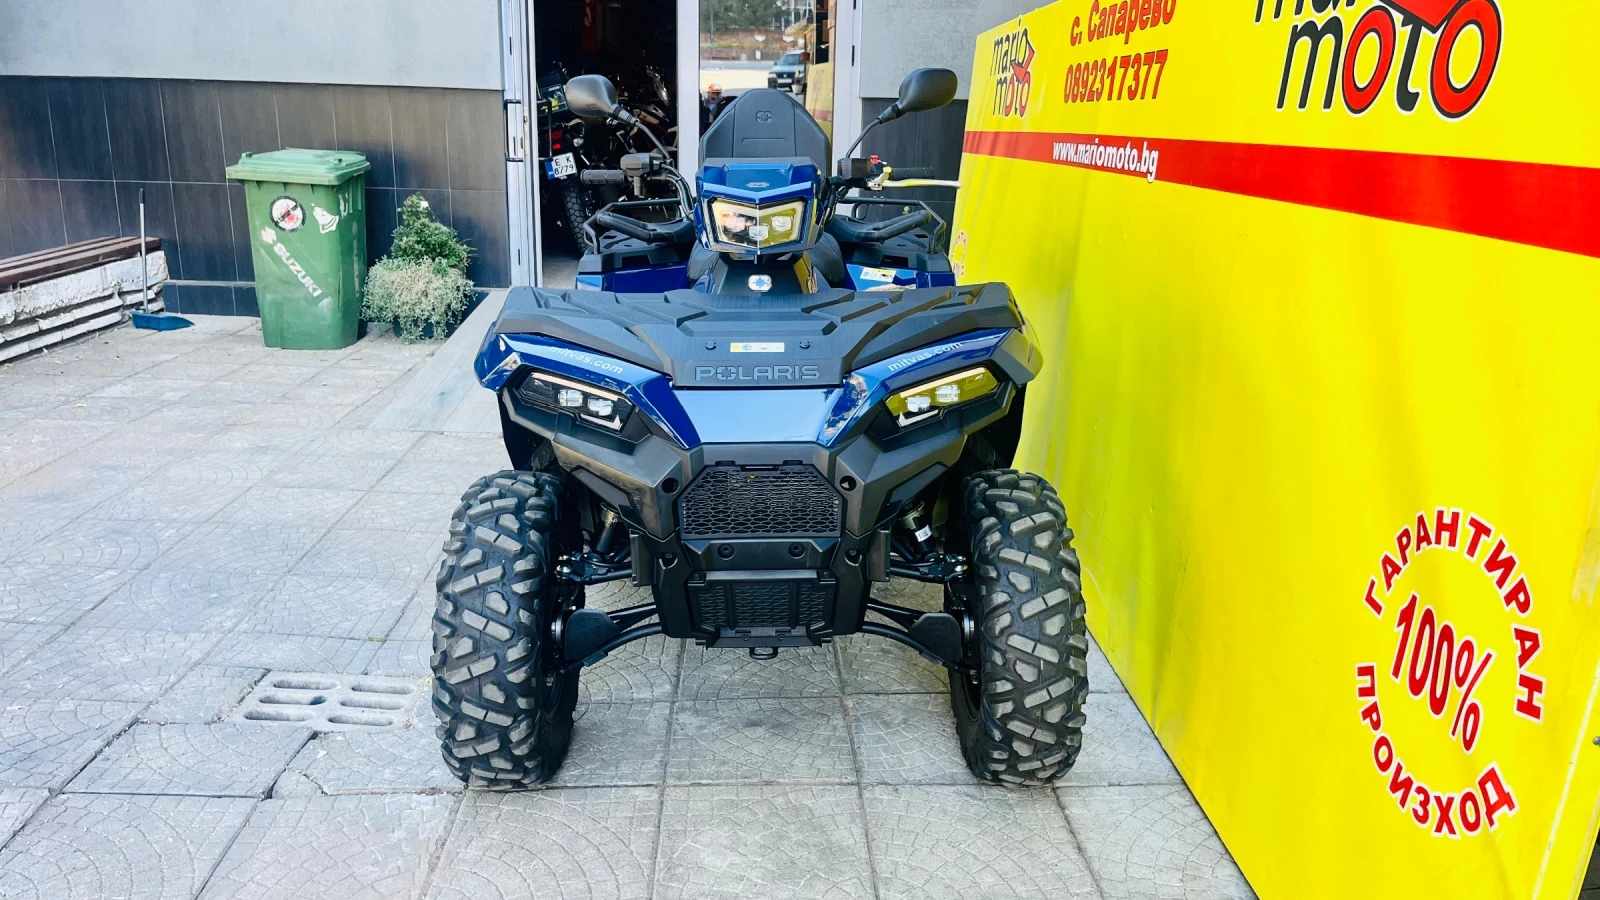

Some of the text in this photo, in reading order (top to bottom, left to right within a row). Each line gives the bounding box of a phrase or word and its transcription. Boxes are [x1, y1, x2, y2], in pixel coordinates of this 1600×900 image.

[1087, 0, 1176, 45] Сапарево
[1064, 49, 1169, 104] 0892317377
[1277, 0, 1501, 119] moto
[993, 71, 1031, 117] moto
[1052, 138, 1159, 183] www.mariomoto.bg
[273, 242, 322, 297] SUZUKI
[548, 346, 624, 374] mitvas.com
[695, 365, 820, 381] POLARIS
[888, 342, 963, 371] mitvas.com
[1364, 509, 1542, 720] ГАРАНТИРАН
[1391, 593, 1493, 751] 100%
[1357, 665, 1516, 835] ПРОИЗХОД
